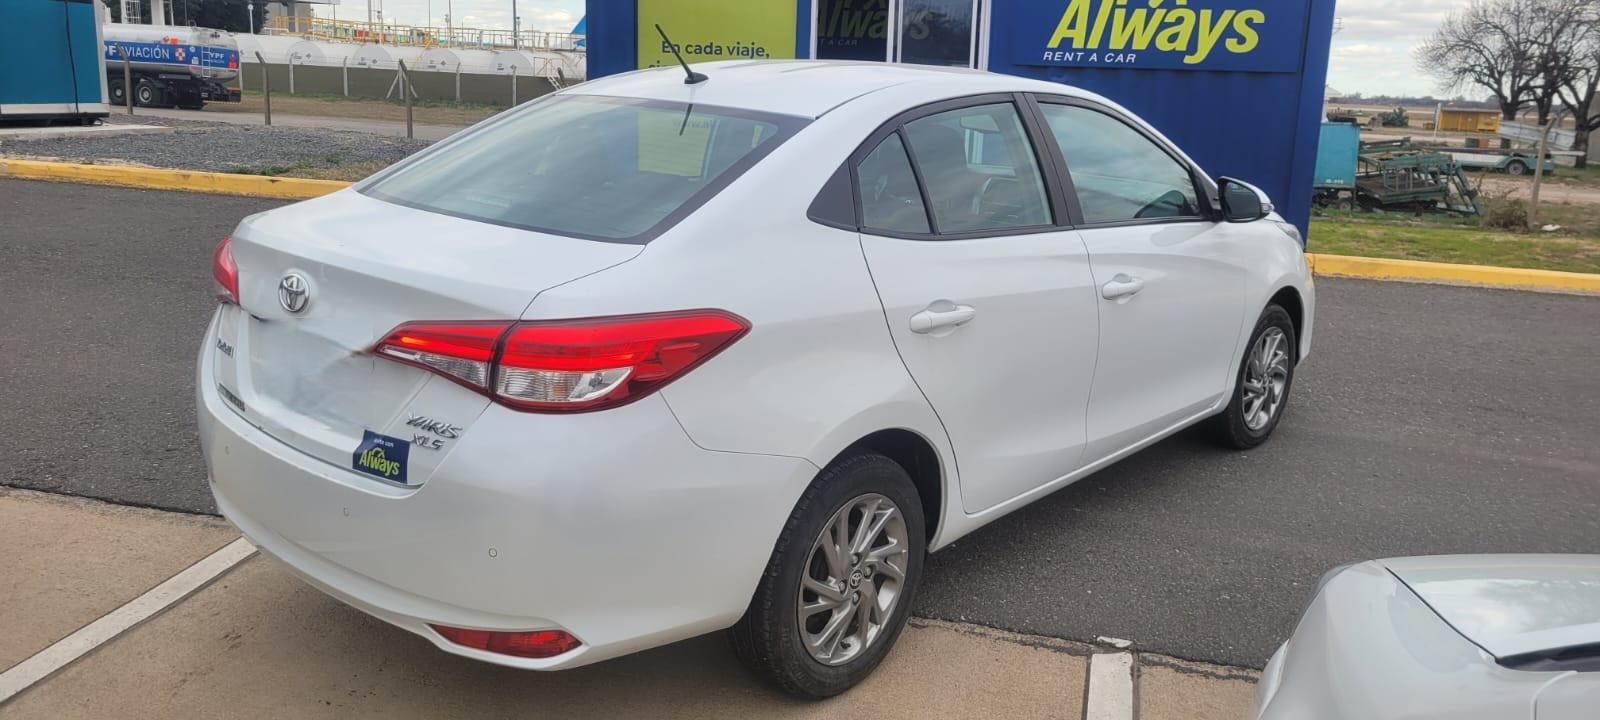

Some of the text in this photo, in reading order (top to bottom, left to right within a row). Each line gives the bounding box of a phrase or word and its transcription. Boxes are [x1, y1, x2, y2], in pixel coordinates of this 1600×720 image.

[1047, 0, 1264, 64] Always
[662, 40, 769, 59] En cada viaje,
[1043, 51, 1136, 64] RENT A CAR
[406, 412, 462, 438] YARIS
[414, 433, 444, 450] XLS
[359, 449, 400, 476] Always
